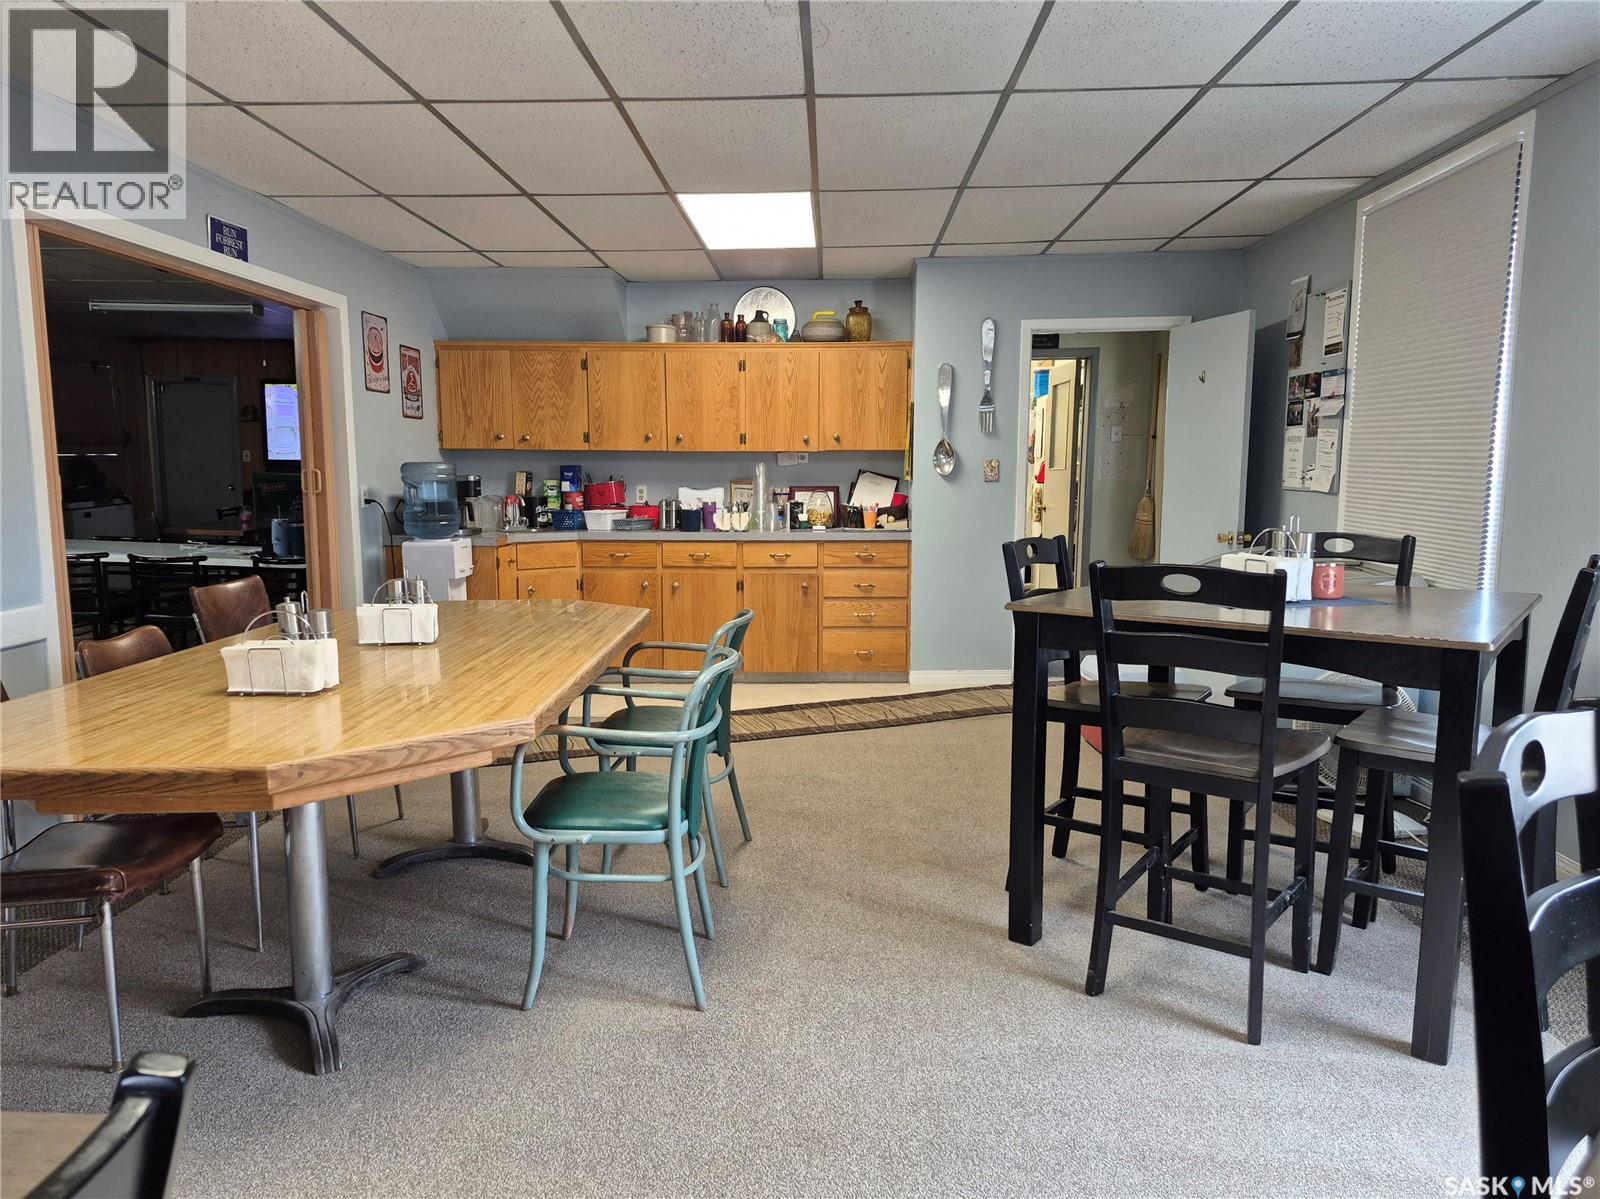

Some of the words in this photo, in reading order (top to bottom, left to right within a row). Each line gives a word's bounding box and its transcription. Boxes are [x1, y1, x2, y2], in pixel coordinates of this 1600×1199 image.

[223, 226, 237, 238] RUN
[215, 233, 243, 250] FORREST
[223, 245, 238, 258] RUN
